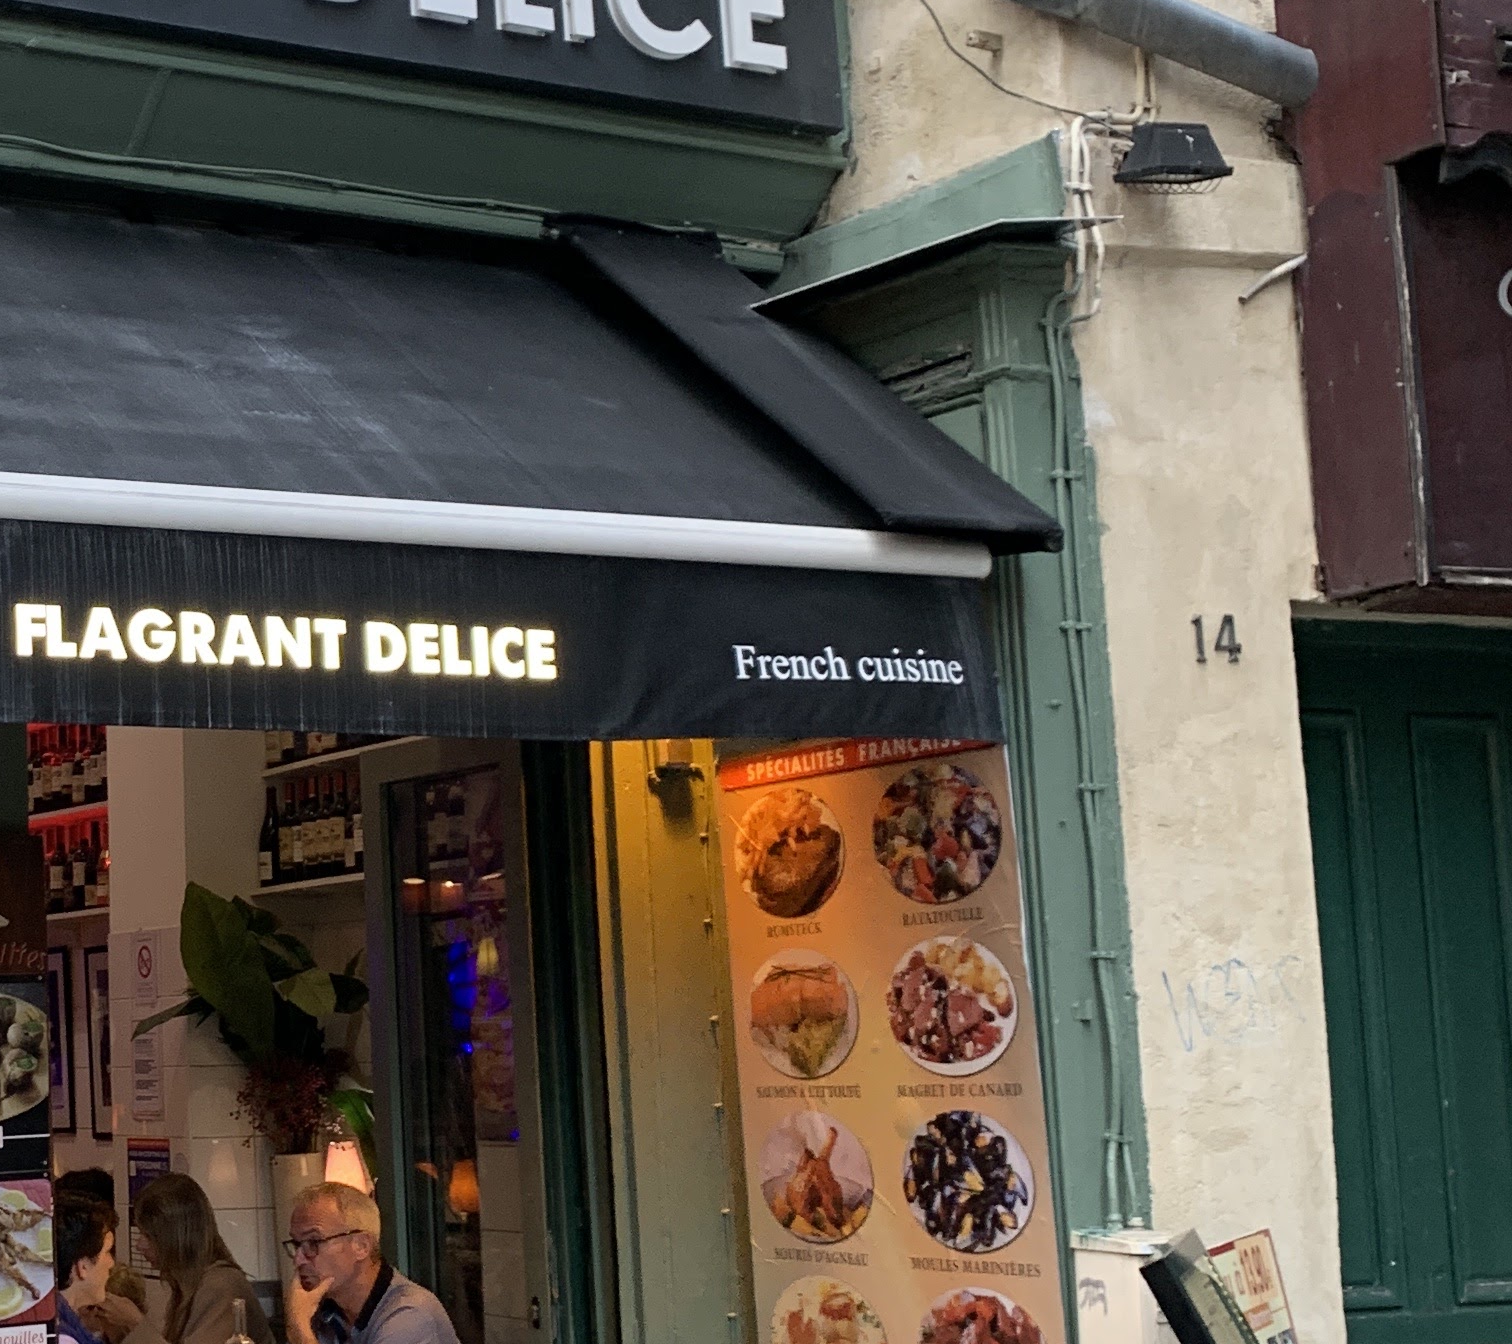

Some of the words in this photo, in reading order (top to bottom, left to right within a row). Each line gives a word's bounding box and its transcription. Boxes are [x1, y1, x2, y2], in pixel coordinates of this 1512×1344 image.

[14, 602, 346, 670] FLAGRANT
[365, 620, 557, 680] DELICE
[1192, 614, 1242, 664] 14
[733, 645, 851, 681] French
[858, 649, 964, 685] cuisine
[950, 1083, 965, 1097] DE
[969, 1083, 1023, 1097] CANARD
